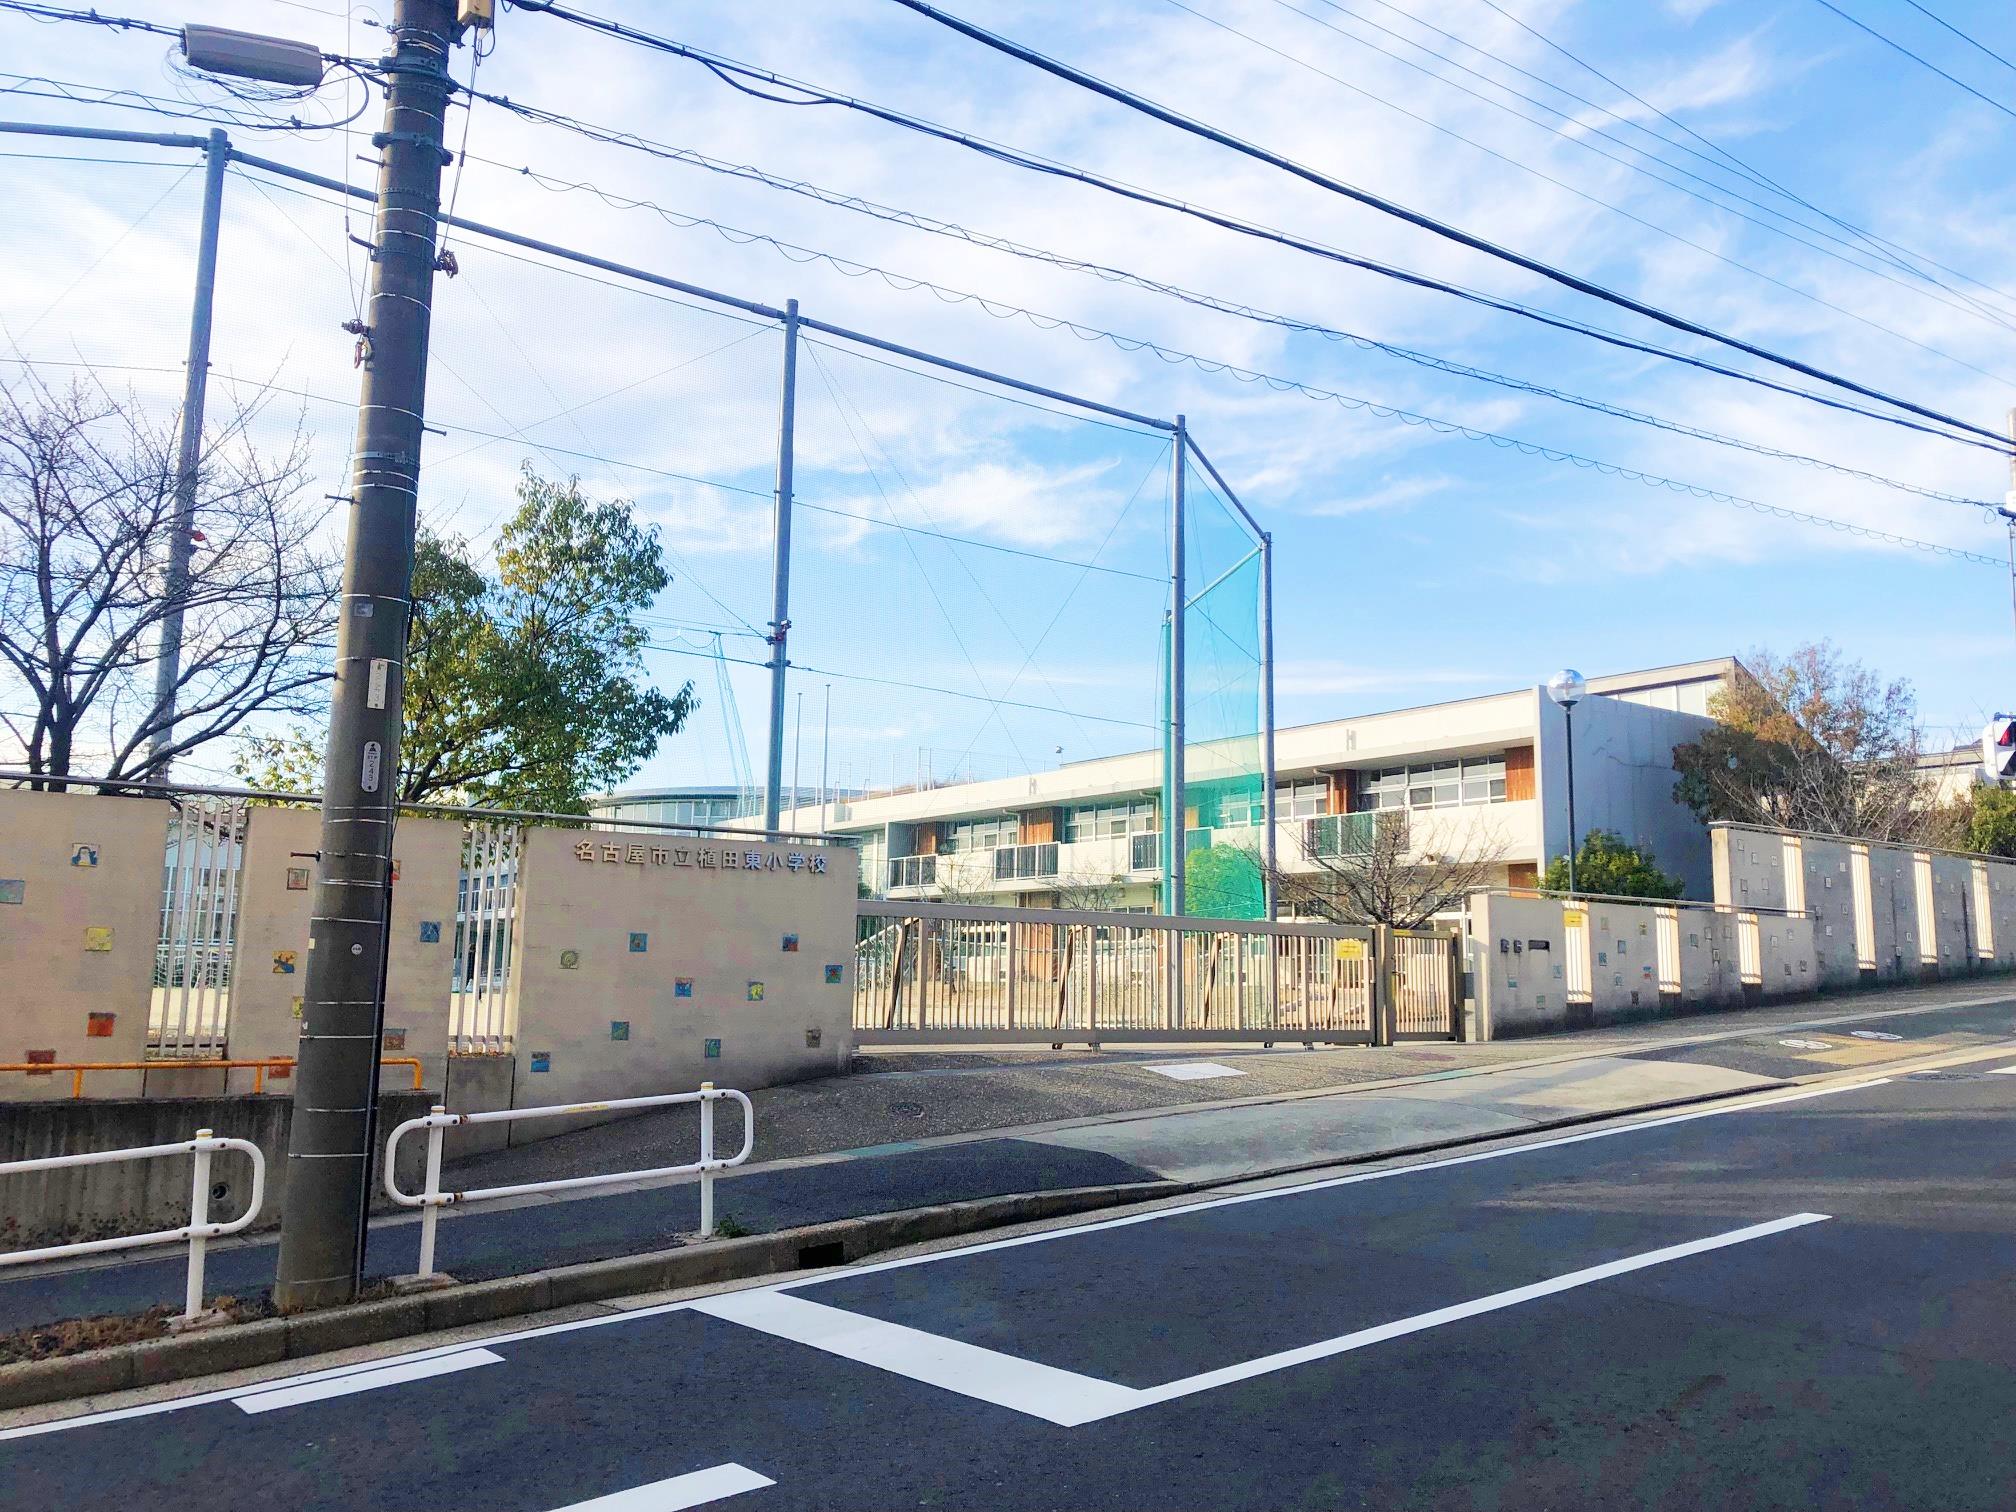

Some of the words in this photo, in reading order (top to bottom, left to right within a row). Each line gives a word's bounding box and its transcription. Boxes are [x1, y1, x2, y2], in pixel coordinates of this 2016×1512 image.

[574, 838, 828, 874] 名古屋市立植田東小学校
